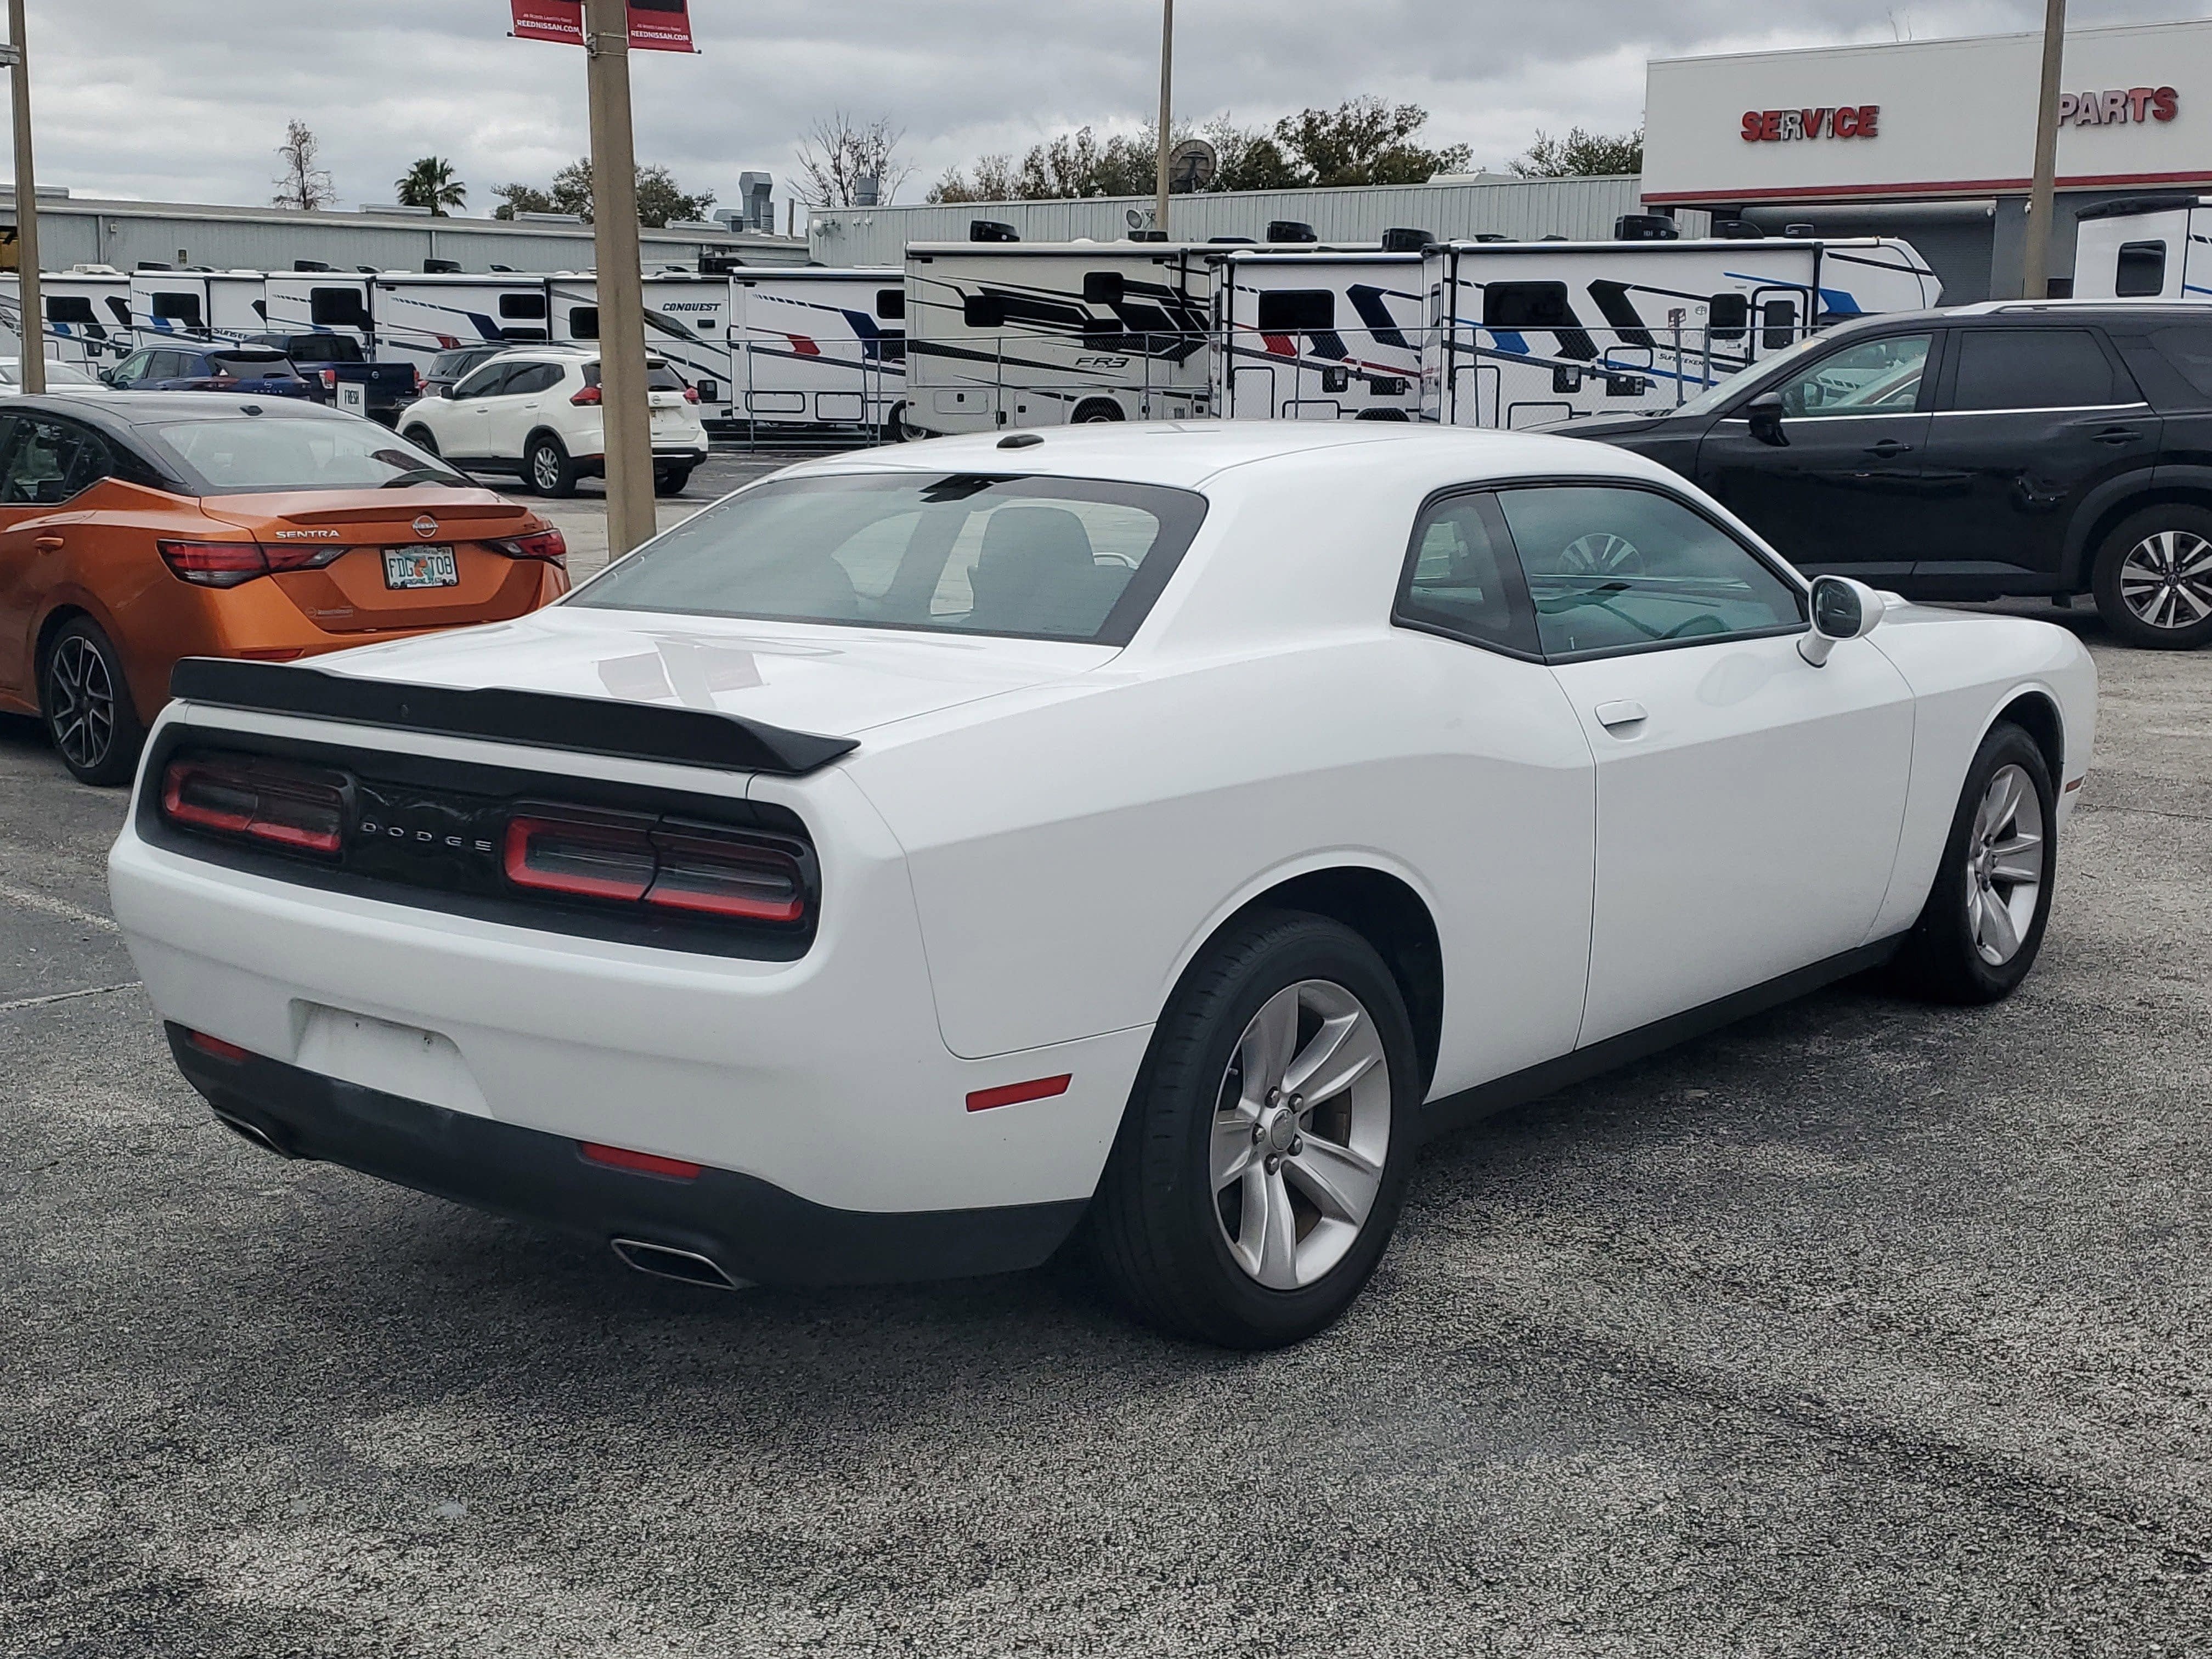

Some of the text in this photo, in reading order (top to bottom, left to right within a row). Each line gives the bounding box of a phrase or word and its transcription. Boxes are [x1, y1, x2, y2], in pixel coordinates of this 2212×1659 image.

[517, 19, 579, 32] REEDNISSAN.COM
[630, 30, 689, 41] REEDNISSAN.COM
[2058, 86, 2179, 127] PARTS
[1741, 105, 1880, 141] SERVICE
[662, 303, 721, 311] CONQUEST
[1075, 357, 1130, 368] FR3
[275, 529, 340, 539] SENTRA
[360, 822, 492, 851] DODGE
